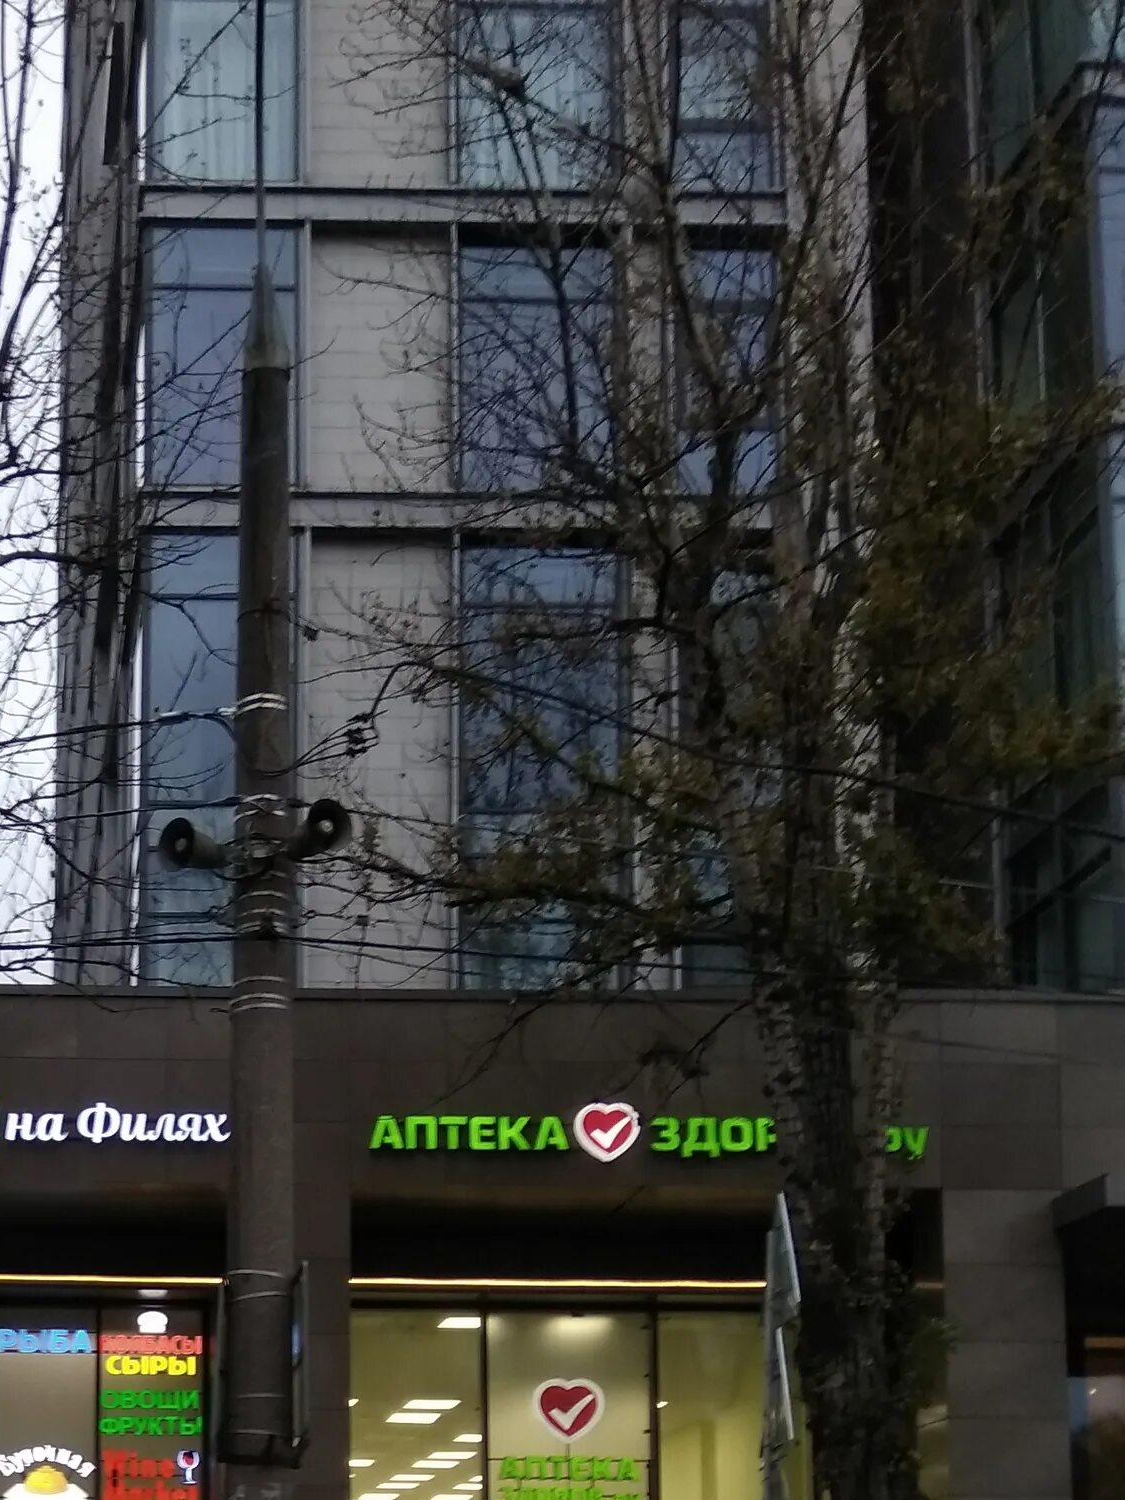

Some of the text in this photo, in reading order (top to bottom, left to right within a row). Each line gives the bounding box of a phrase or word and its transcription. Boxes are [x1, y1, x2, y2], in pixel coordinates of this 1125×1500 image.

[4, 1112, 69, 1142] на
[76, 1102, 232, 1143] Филях
[368, 1114, 571, 1151] АПТЕКА
[105, 1355, 197, 1376] СЫРЫ
[100, 1390, 200, 1411] ОВОЩИ
[99, 1416, 203, 1436] ФРУКТЫ
[500, 1456, 640, 1481] АПТЕКА
